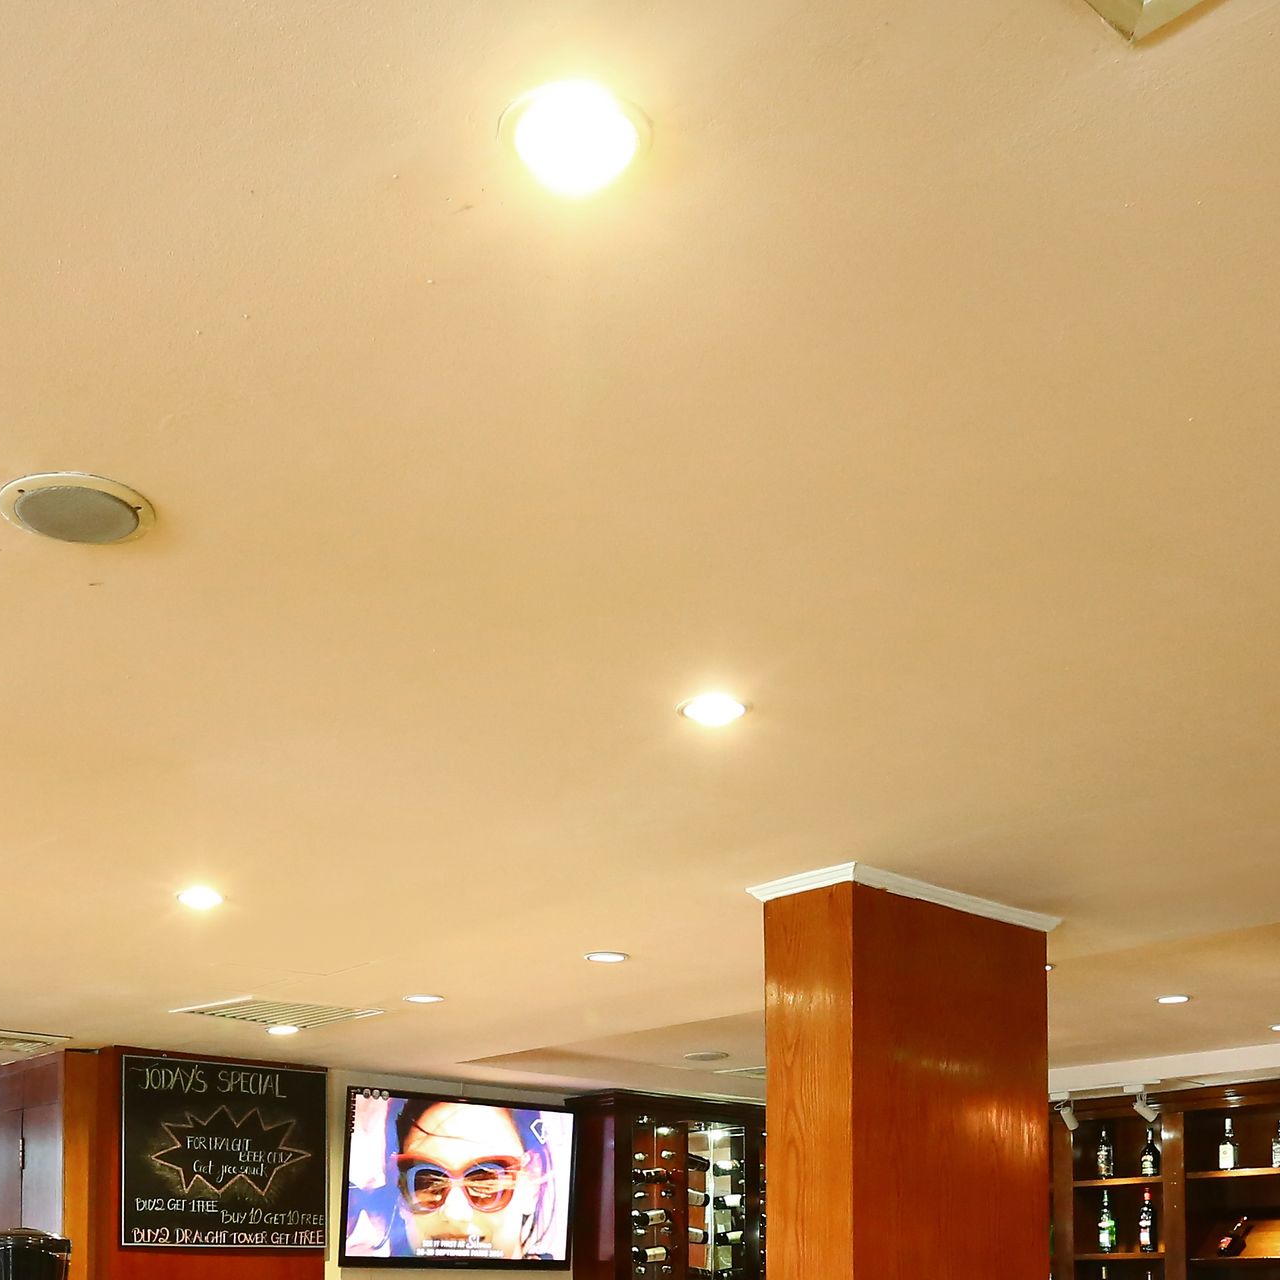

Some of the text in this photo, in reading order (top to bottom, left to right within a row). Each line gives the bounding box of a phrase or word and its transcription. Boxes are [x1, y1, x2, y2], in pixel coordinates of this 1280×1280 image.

[217, 1071, 287, 1098] SPECIAL
[167, 1198, 187, 1212] GET
[220, 1209, 247, 1224] BUY
[248, 1207, 263, 1225] 10
[263, 1212, 287, 1225] GET
[300, 1213, 325, 1226] FREE
[174, 1227, 228, 1244] DRAUGHT
[229, 1231, 268, 1245] TOWER
[270, 1231, 291, 1245] GET
